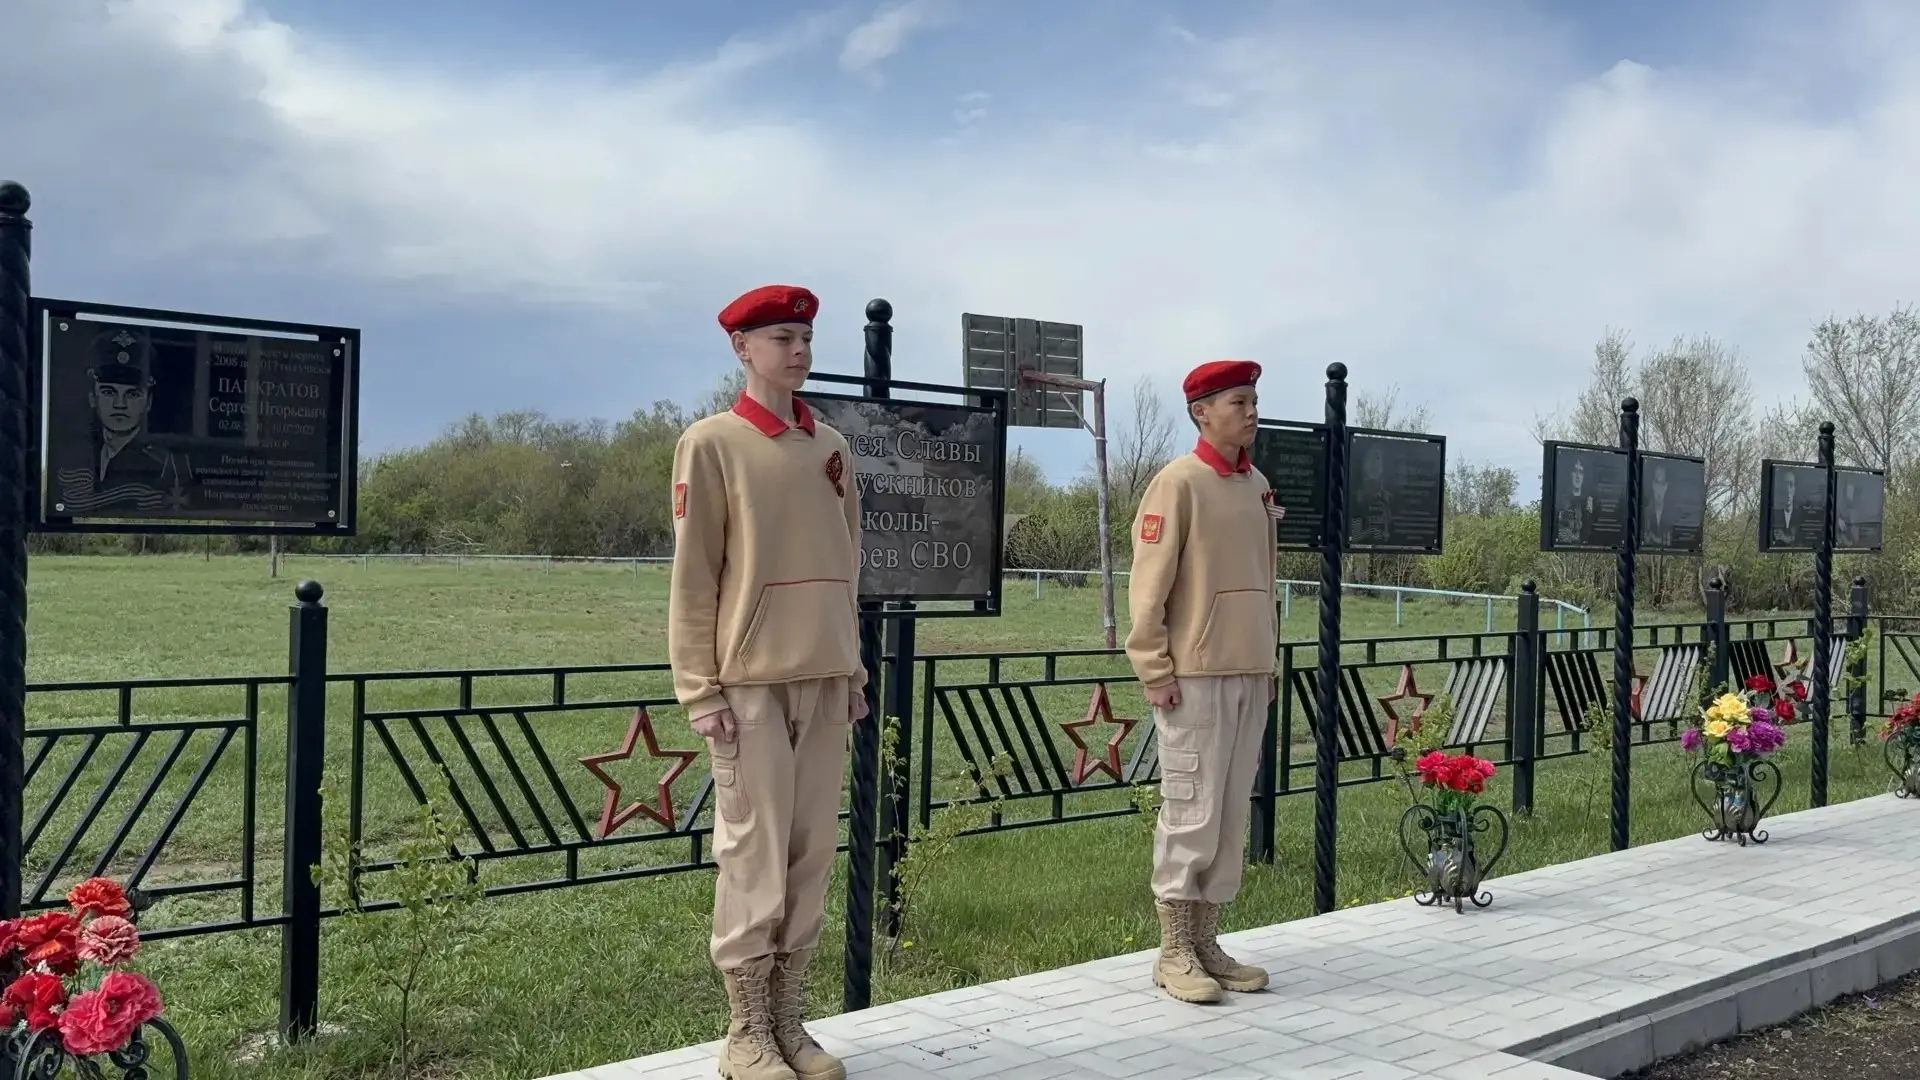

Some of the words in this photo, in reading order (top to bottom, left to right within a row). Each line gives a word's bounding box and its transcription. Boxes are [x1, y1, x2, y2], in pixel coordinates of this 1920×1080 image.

[208, 396, 257, 417] Серге
[896, 430, 981, 463] Славы
[855, 472, 977, 499] ускников
[862, 511, 940, 532] колы-
[910, 540, 972, 569] СВО
